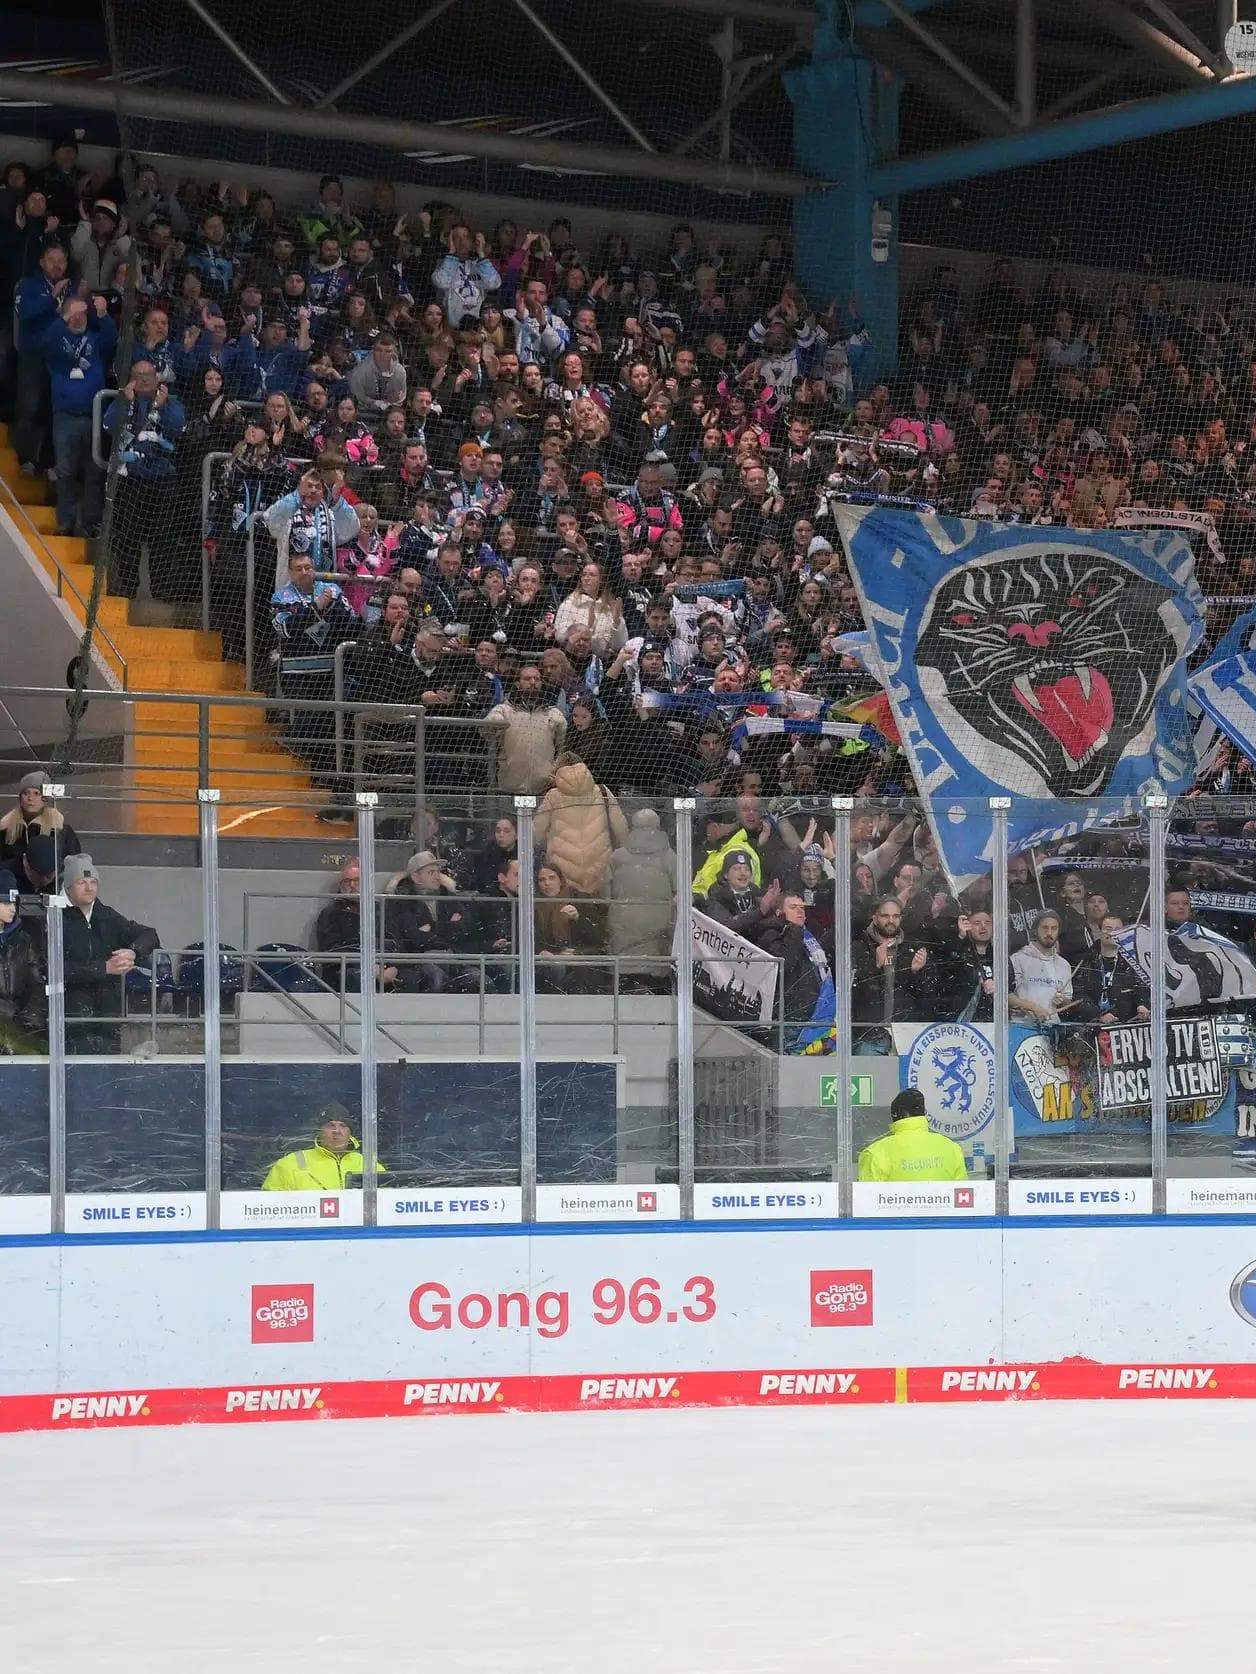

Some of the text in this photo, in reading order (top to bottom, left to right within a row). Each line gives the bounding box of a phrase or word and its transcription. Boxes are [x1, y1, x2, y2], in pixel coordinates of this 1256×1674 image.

[1240, 25, 1253, 35] 15
[970, 1036, 989, 1057] UND
[1101, 1023, 1194, 1067] SERVU TV
[1102, 1060, 1220, 1106] ABSCLTEN!
[560, 1196, 633, 1209] heinemann
[711, 1196, 760, 1208] SMILE
[765, 1195, 806, 1207] EYES
[878, 1192, 951, 1206] heinemann
[1026, 1191, 1075, 1204] SMILE
[1080, 1190, 1121, 1203] EYES
[82, 1207, 131, 1220] SMILE
[136, 1206, 177, 1219] EYES
[243, 1203, 317, 1216] heinemann
[395, 1201, 443, 1214] SMILE
[448, 1200, 490, 1212] EYES
[829, 1282, 864, 1294] Radio
[270, 1297, 305, 1309] Radio
[815, 1290, 868, 1306] Gong
[255, 1305, 309, 1322] Gong
[408, 1275, 717, 1339] Gong 96.3
[829, 1302, 857, 1313] 96.3
[270, 1317, 298, 1329] 96.3
